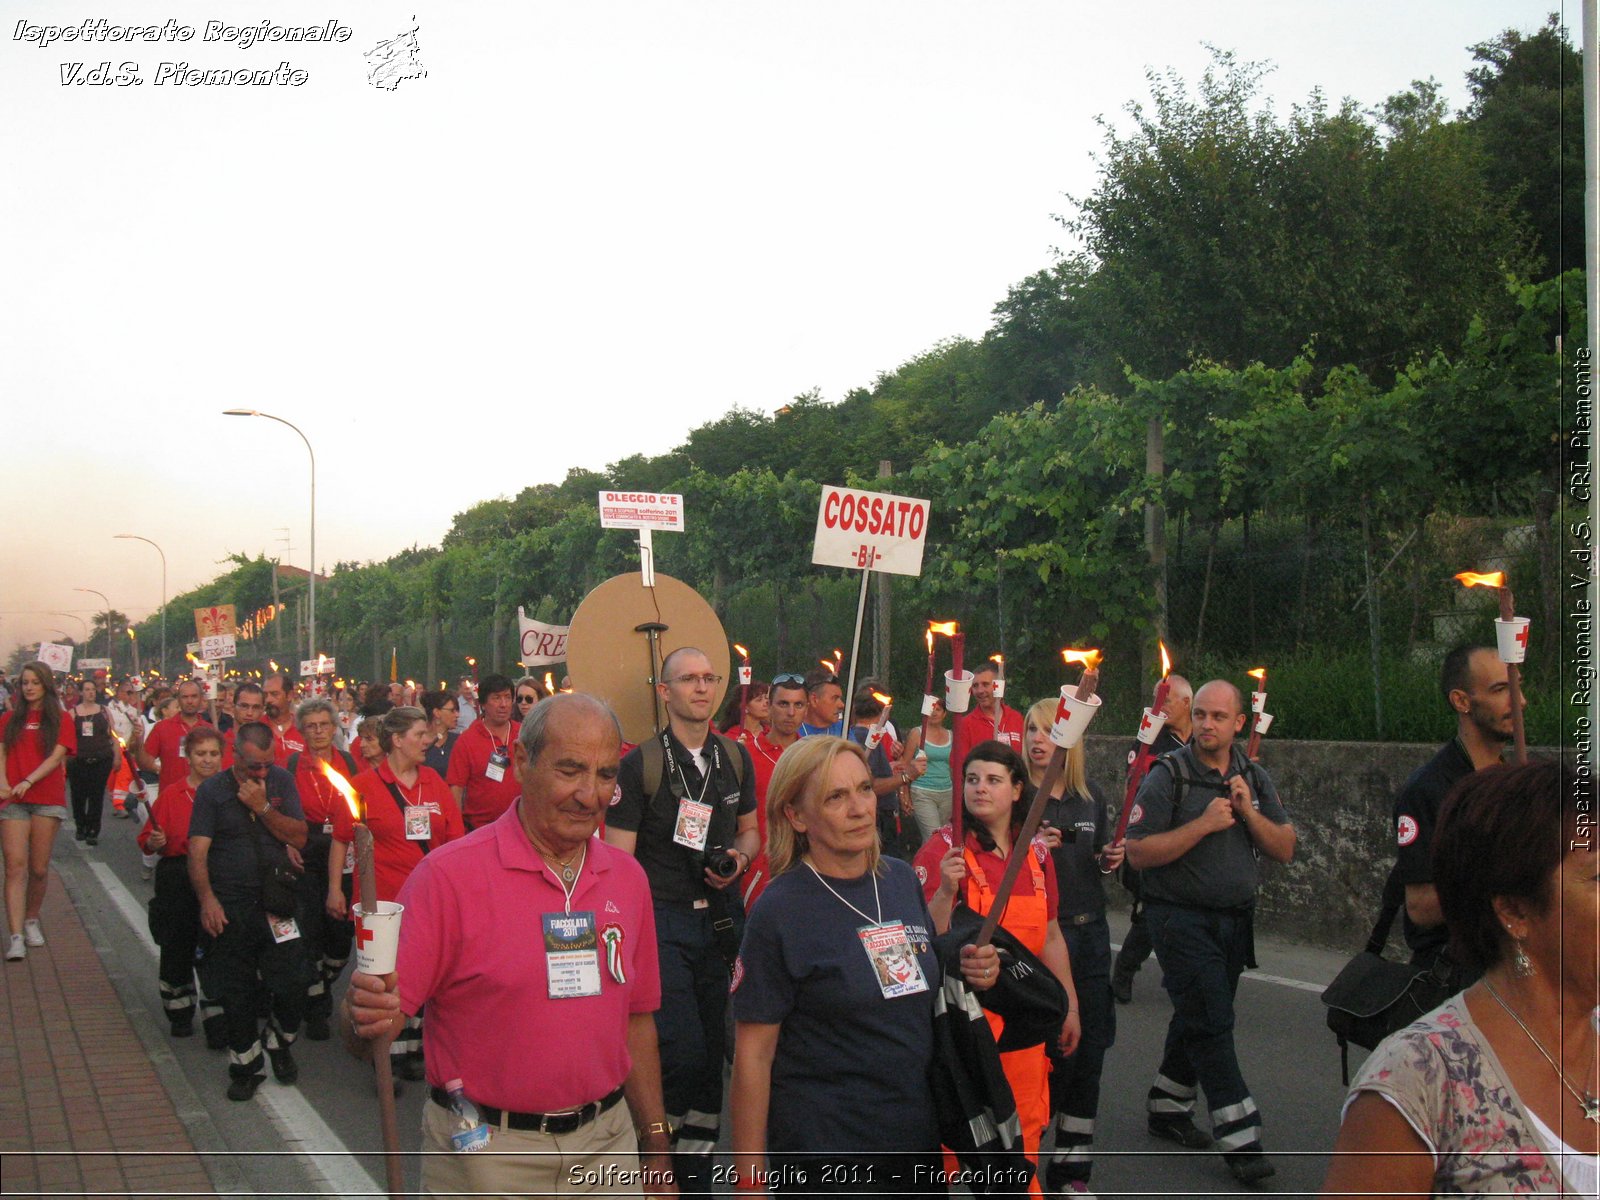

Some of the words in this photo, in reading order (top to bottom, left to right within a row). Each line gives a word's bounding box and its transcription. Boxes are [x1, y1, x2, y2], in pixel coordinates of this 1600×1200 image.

[606, 493, 656, 503] OLEGGIO
[824, 491, 924, 540] COSSATO
[550, 918, 588, 929] FIACCOLATA
[563, 928, 578, 937] 2011
